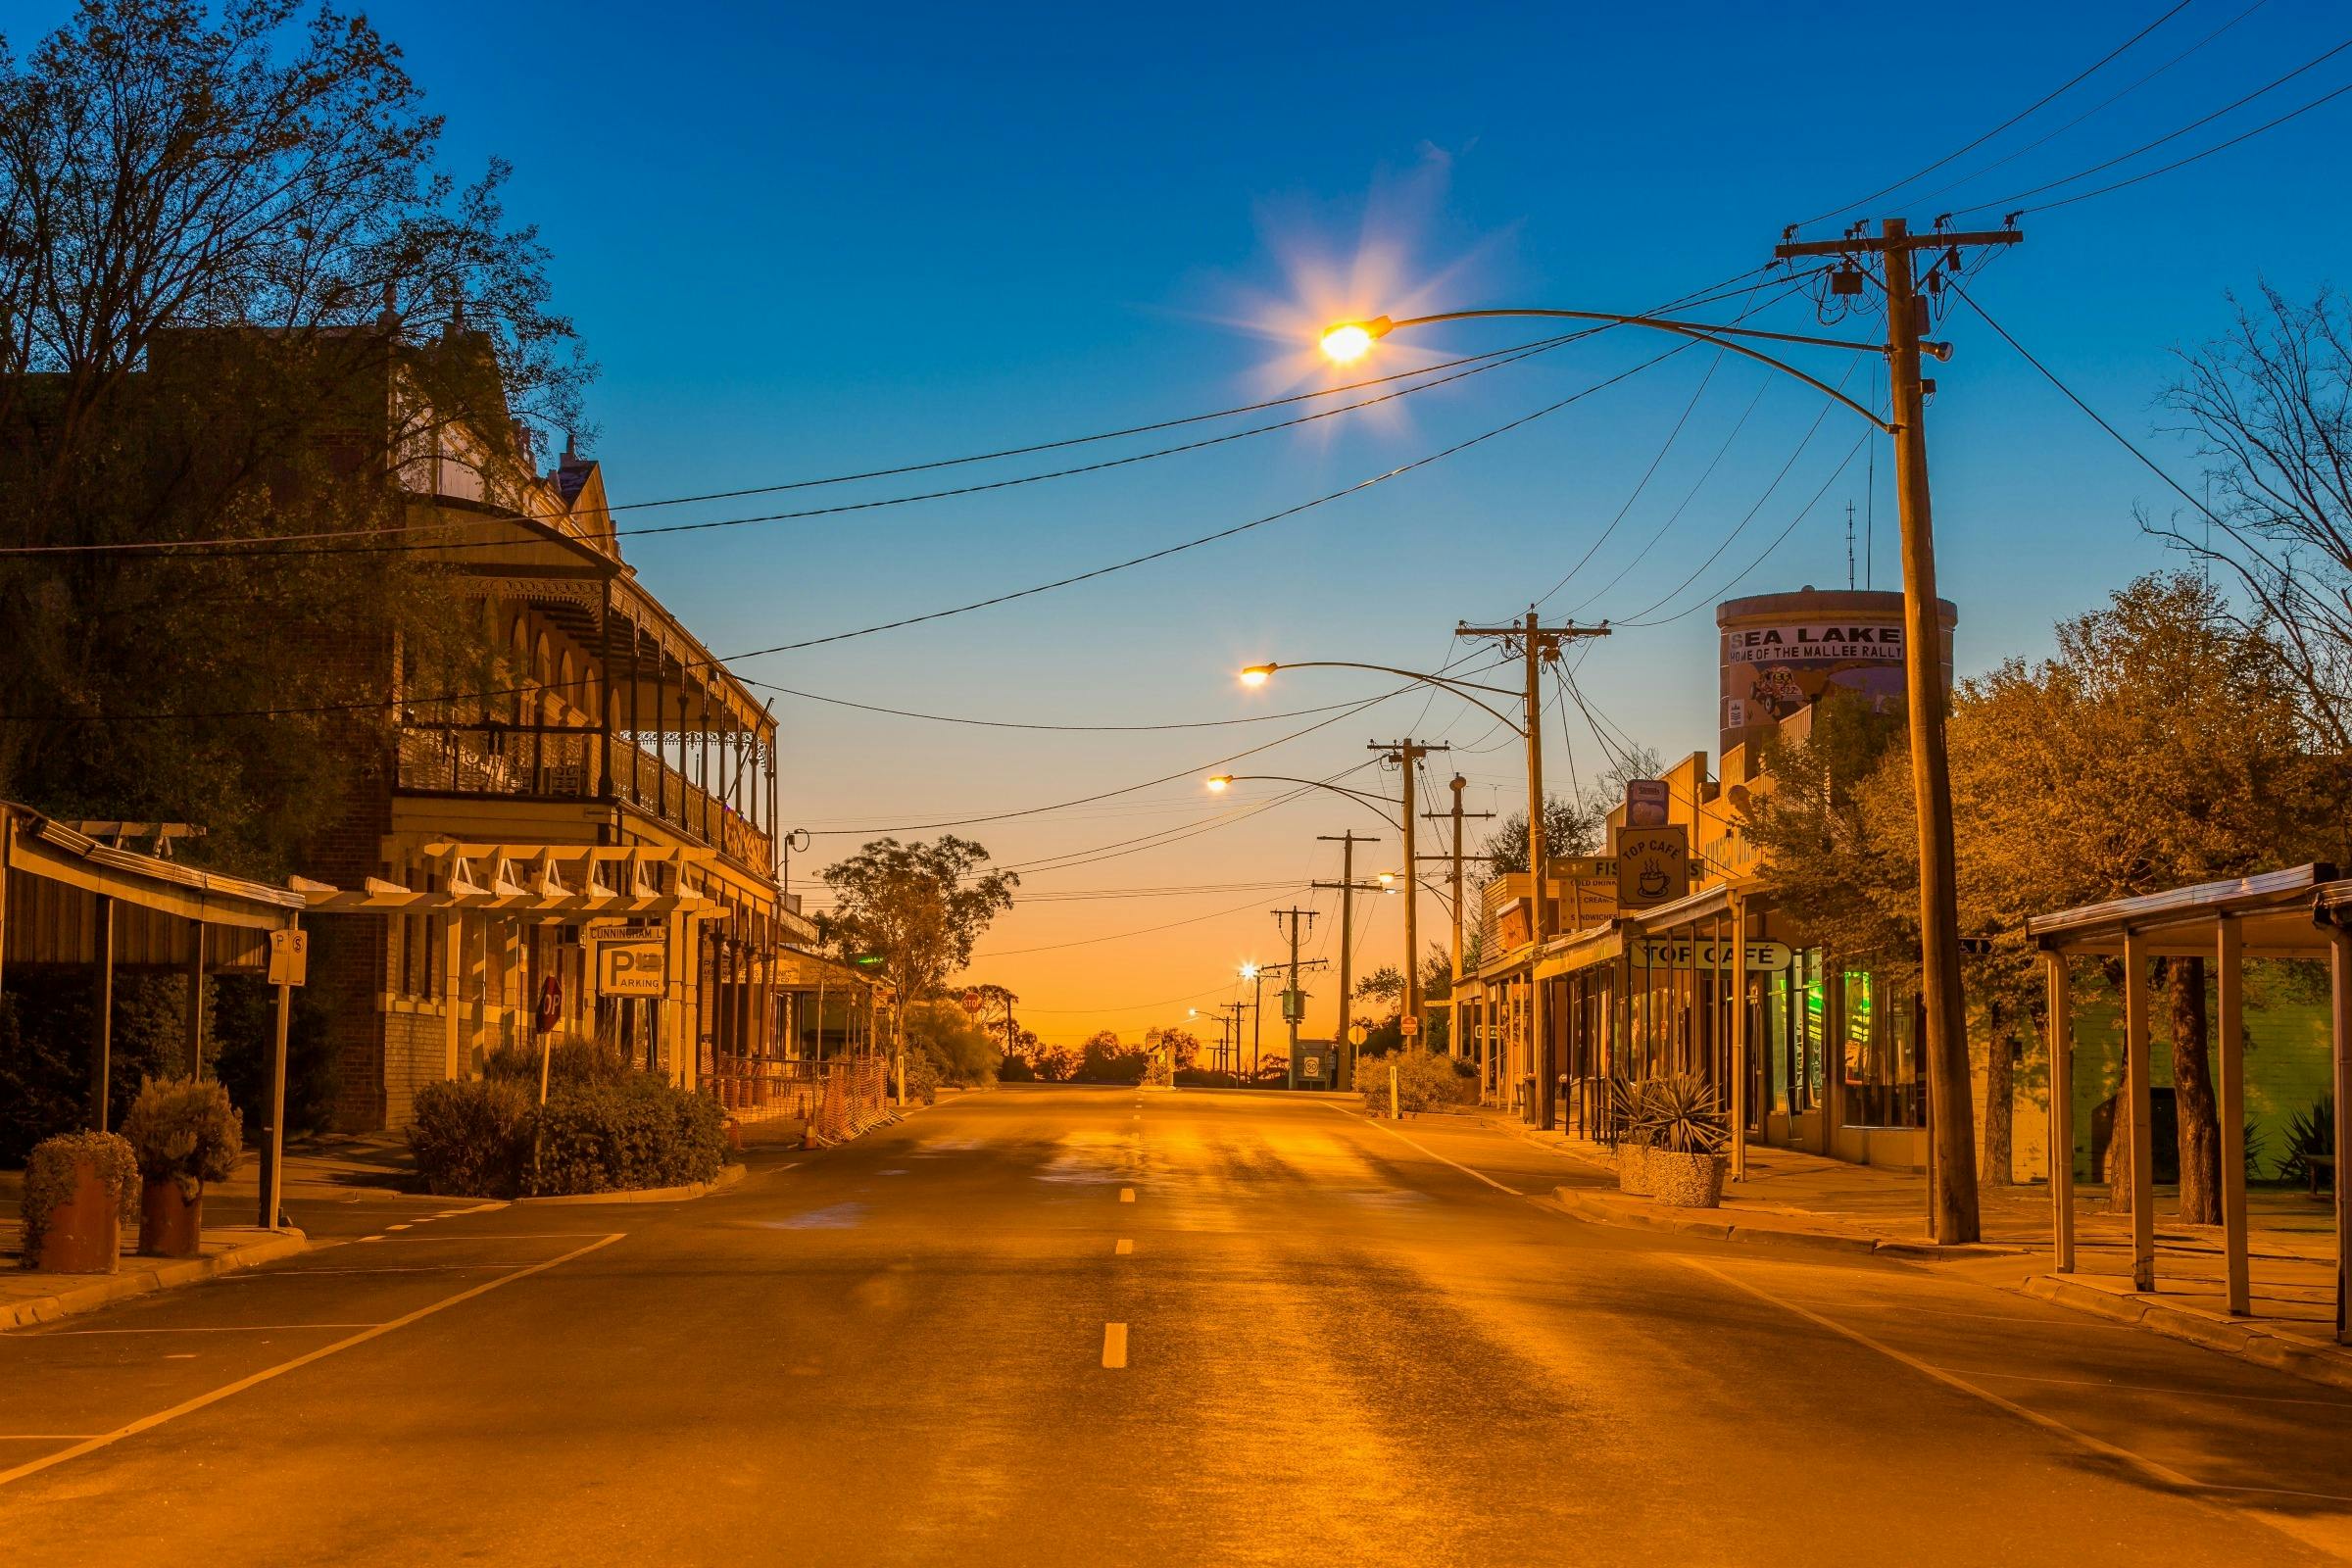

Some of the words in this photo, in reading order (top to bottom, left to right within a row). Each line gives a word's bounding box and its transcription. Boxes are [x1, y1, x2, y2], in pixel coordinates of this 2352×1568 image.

[1732, 630, 1784, 648] SEA
[1797, 628, 1901, 643] LAKE
[1730, 650, 1752, 662] HOME
[1756, 648, 1769, 660] OF
[1774, 647, 1799, 658] THE
[1804, 646, 1857, 657] MALLEE
[1862, 646, 1901, 658] RALLY
[1623, 841, 1644, 860] TOP
[1595, 862, 1617, 875] FIS
[590, 928, 651, 939] CUNNINGHAM
[1643, 946, 1692, 962] TOP
[1703, 945, 1774, 964] CAFÉ
[543, 994, 561, 1015] OP
